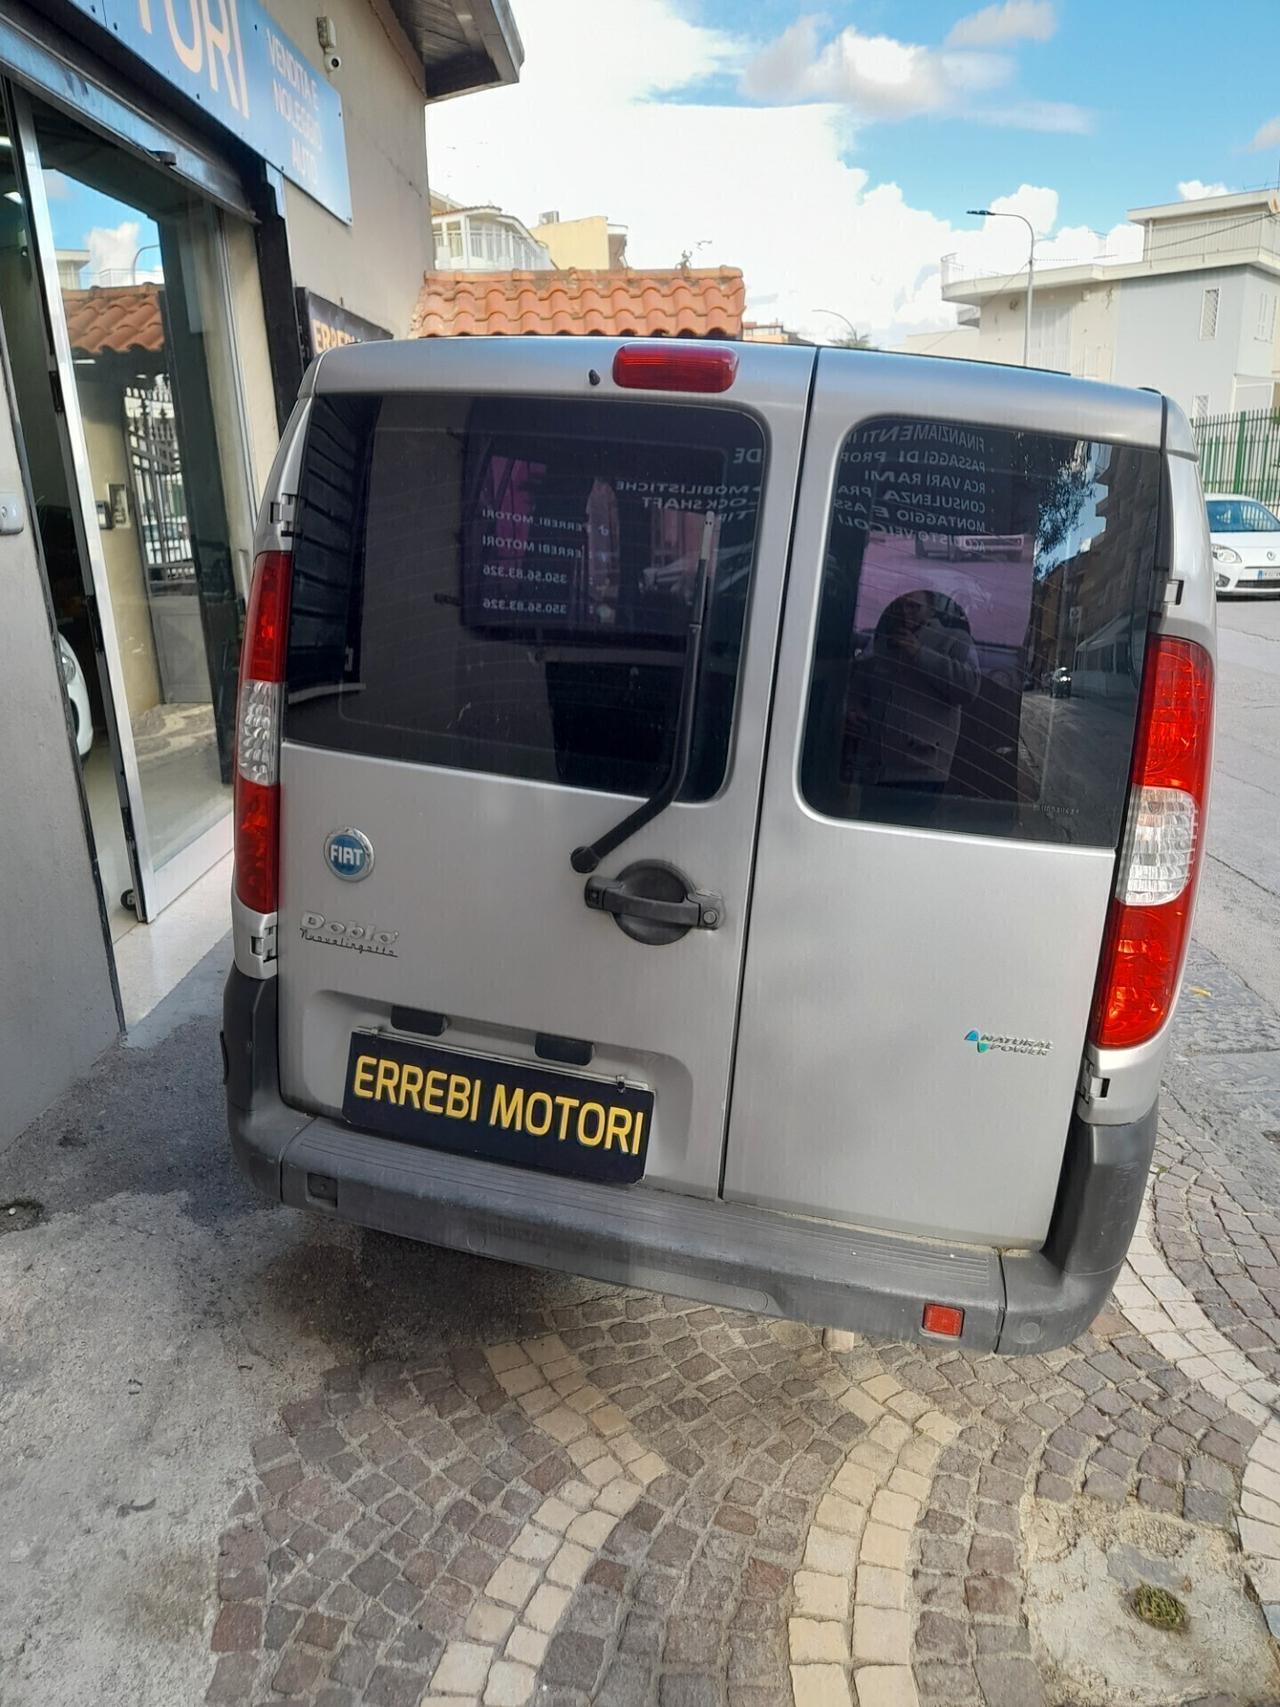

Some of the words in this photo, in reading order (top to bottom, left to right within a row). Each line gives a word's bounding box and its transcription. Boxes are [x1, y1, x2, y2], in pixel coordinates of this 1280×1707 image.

[266, 28, 313, 104] VENDITA
[330, 844, 364, 866] FIAT
[980, 1034, 1053, 1050] NATURAL
[990, 1043, 1047, 1056] POWER
[353, 1055, 482, 1122] ERREBI
[488, 1083, 645, 1156] MOTORI
